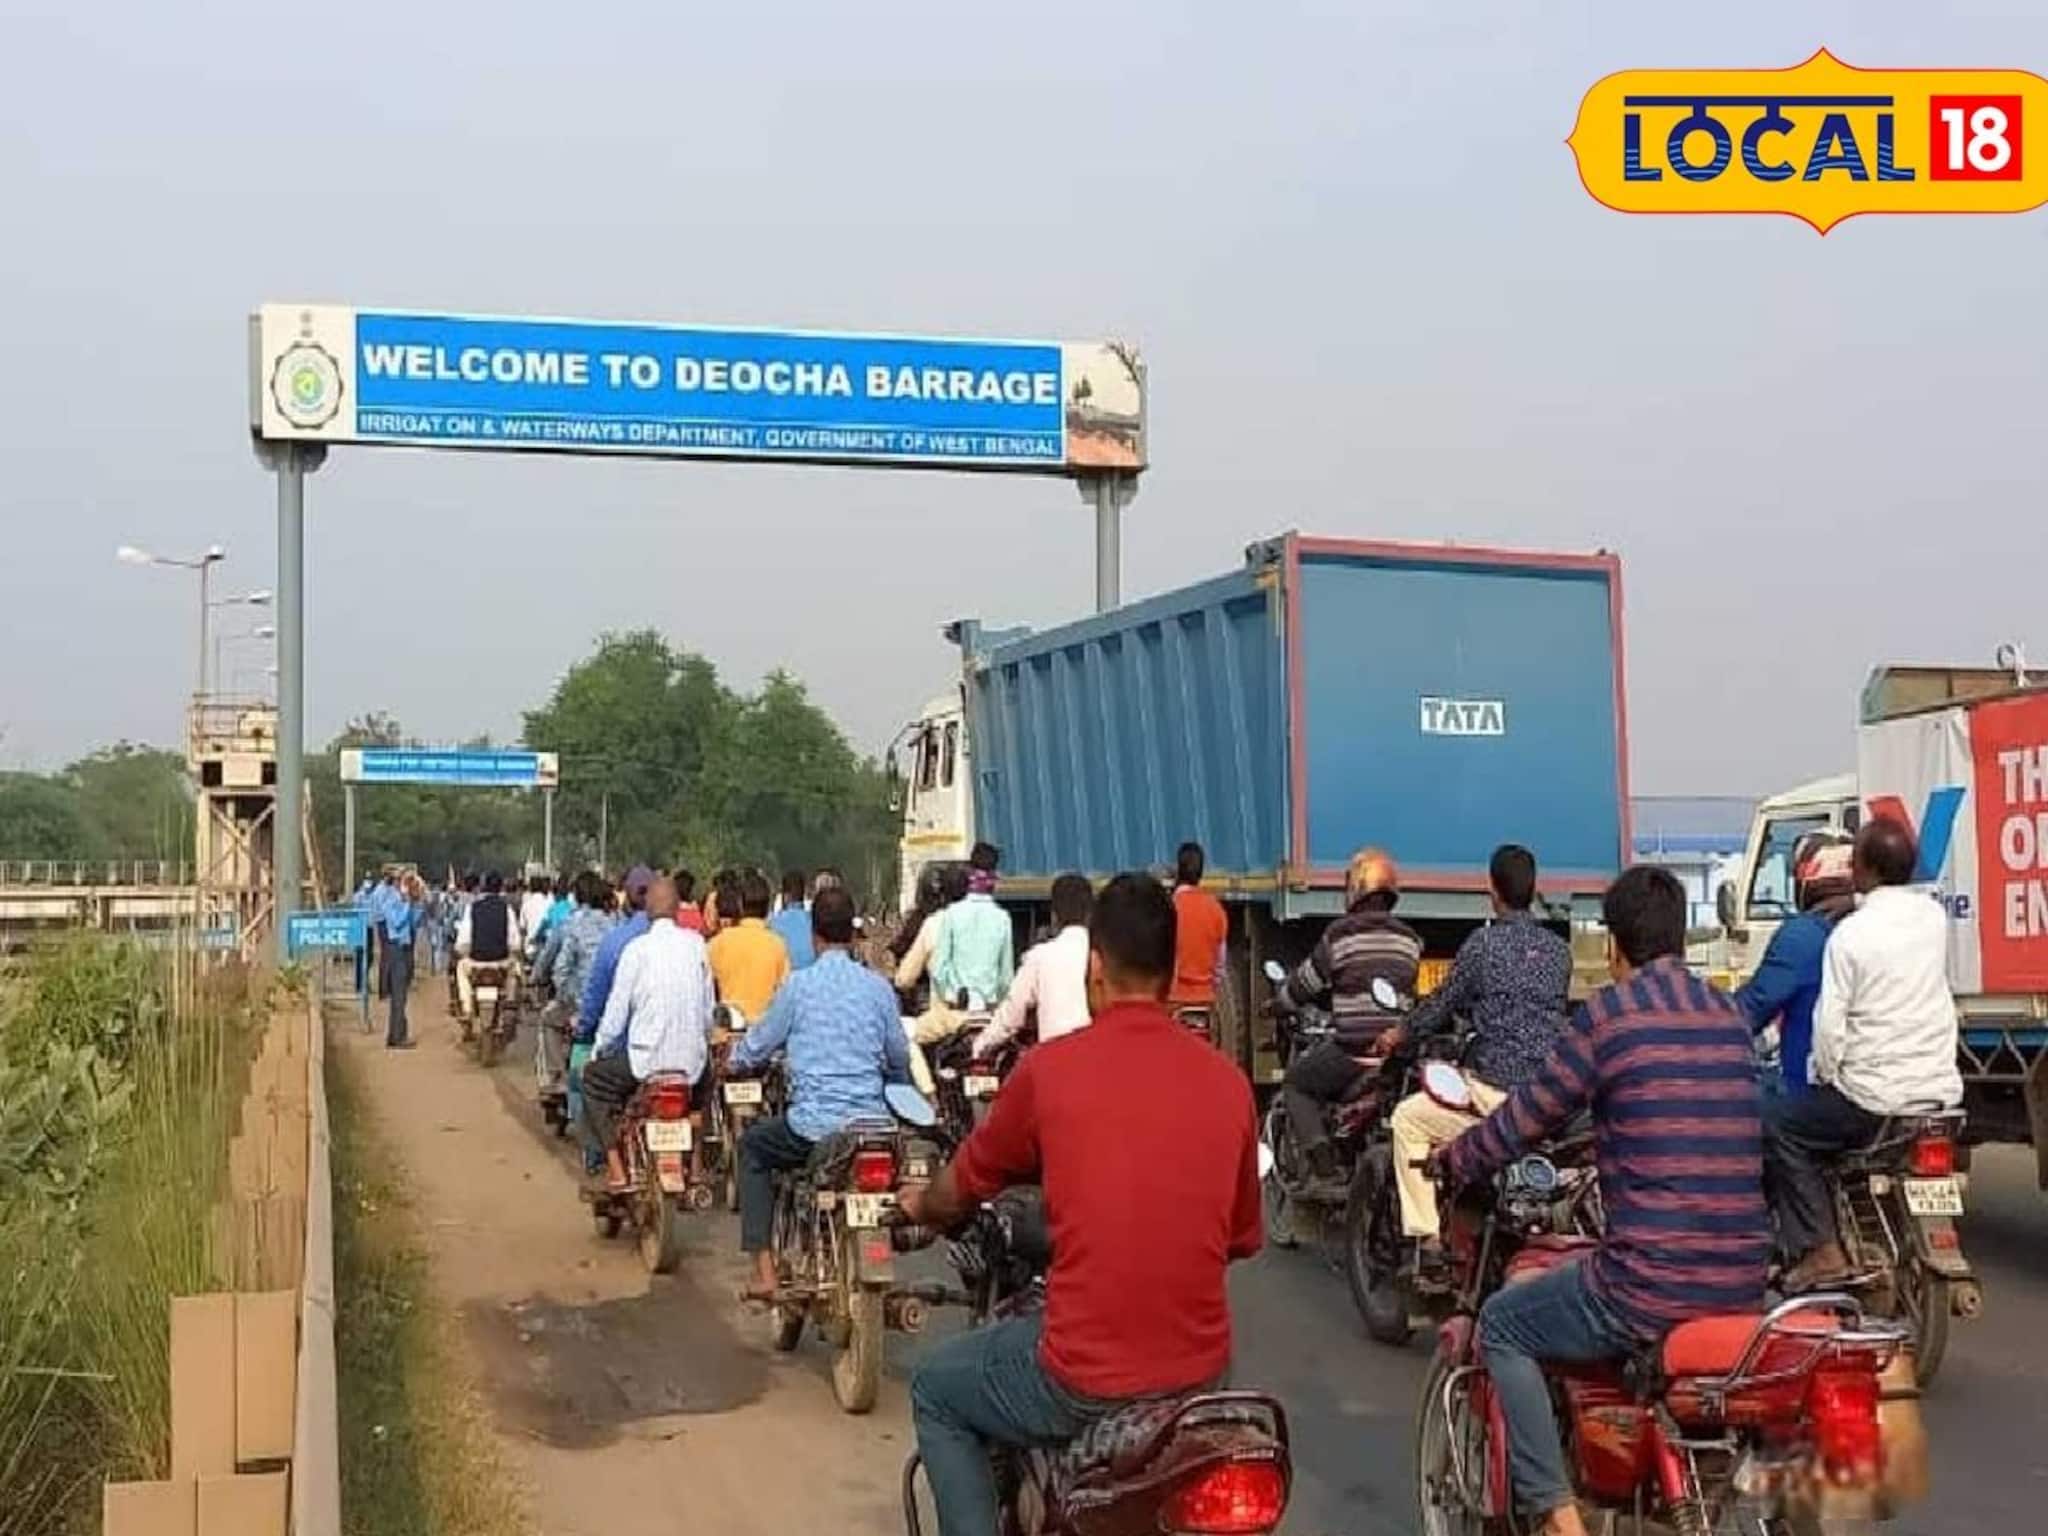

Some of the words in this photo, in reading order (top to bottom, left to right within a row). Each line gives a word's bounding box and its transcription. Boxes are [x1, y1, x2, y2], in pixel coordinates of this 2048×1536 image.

[363, 343, 590, 386] WELCOME
[602, 354, 660, 388] TO
[676, 359, 853, 396] DEOCHA
[866, 366, 1058, 405] BARRAGE
[359, 413, 476, 433] IRRIGATON
[482, 418, 496, 434] &
[501, 418, 624, 440] WATERWAYS
[766, 429, 896, 450] GOVERNMENT
[902, 433, 925, 450] OF
[929, 433, 977, 452] WEST
[985, 436, 1057, 456] BENGAL
[1424, 703, 1501, 731] TATA
[299, 929, 348, 945] POLICE
